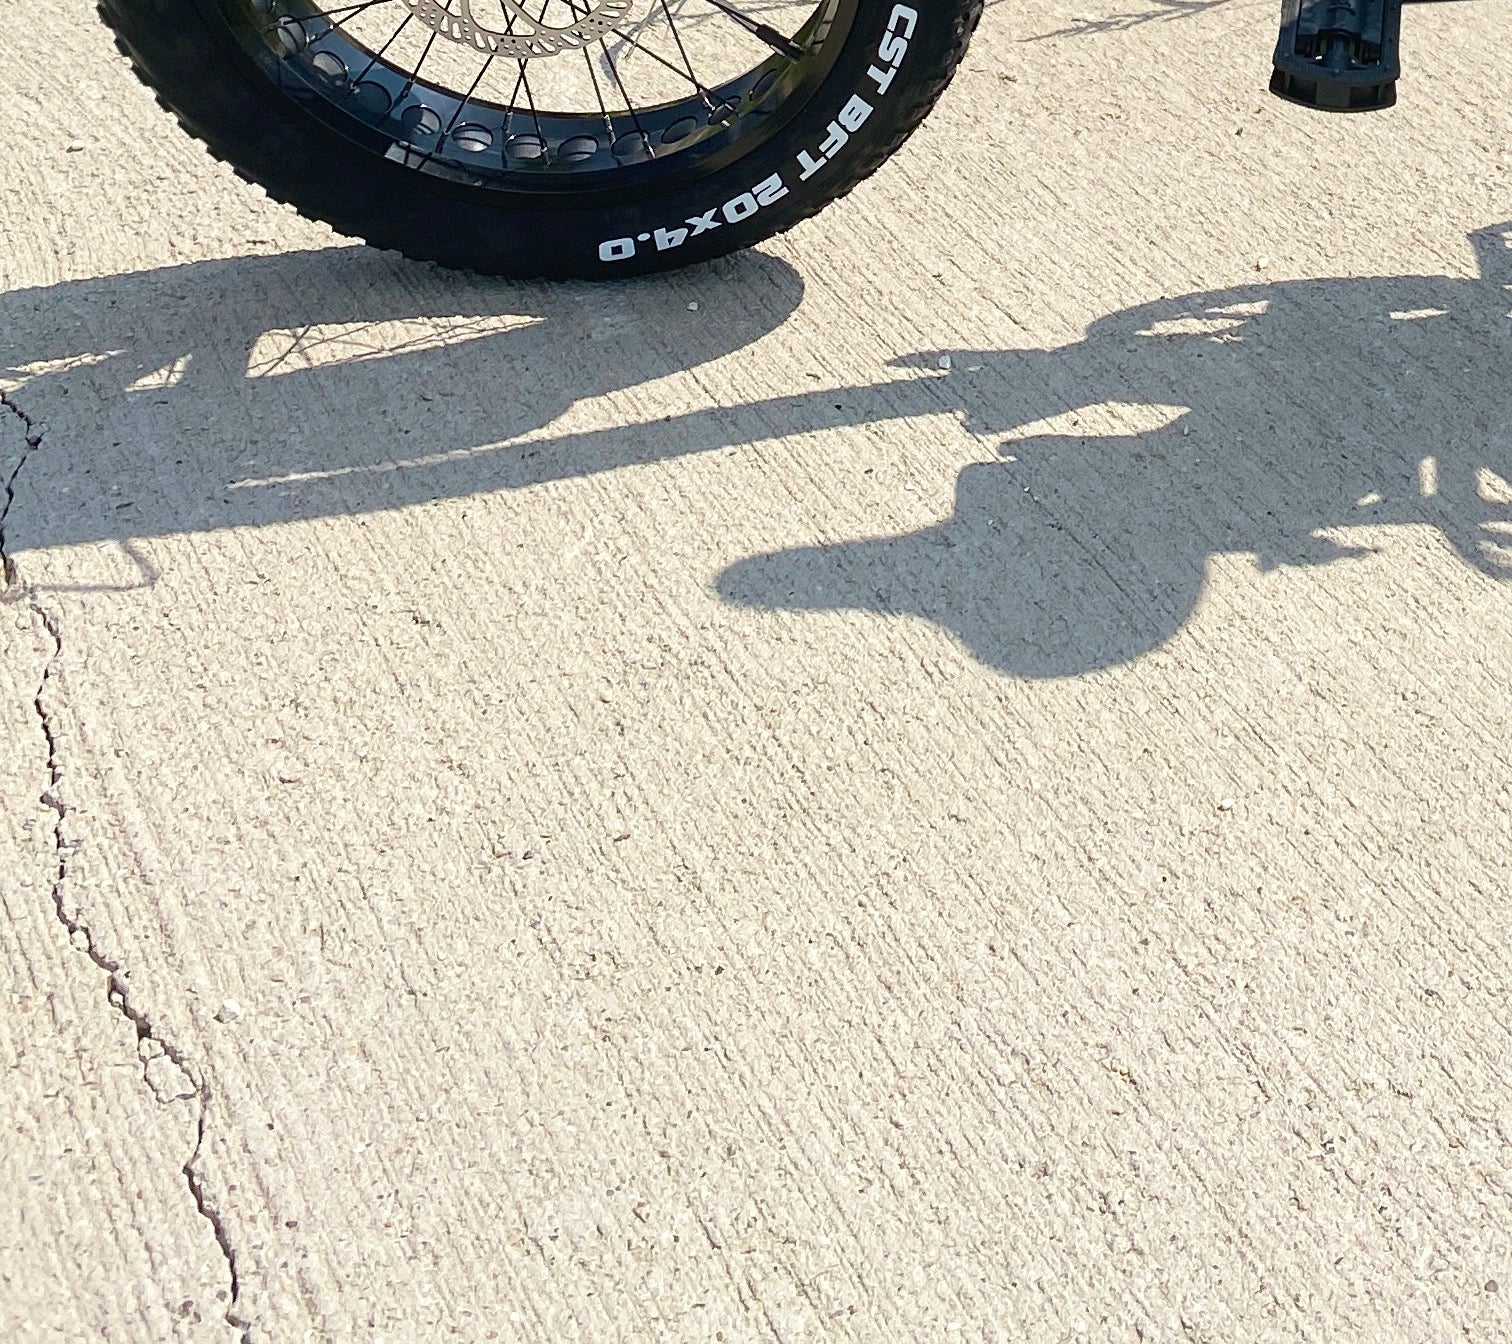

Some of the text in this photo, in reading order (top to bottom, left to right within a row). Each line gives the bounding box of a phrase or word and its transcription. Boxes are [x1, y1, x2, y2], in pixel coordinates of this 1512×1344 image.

[598, 3, 918, 262] CST BFT 20x4.0
